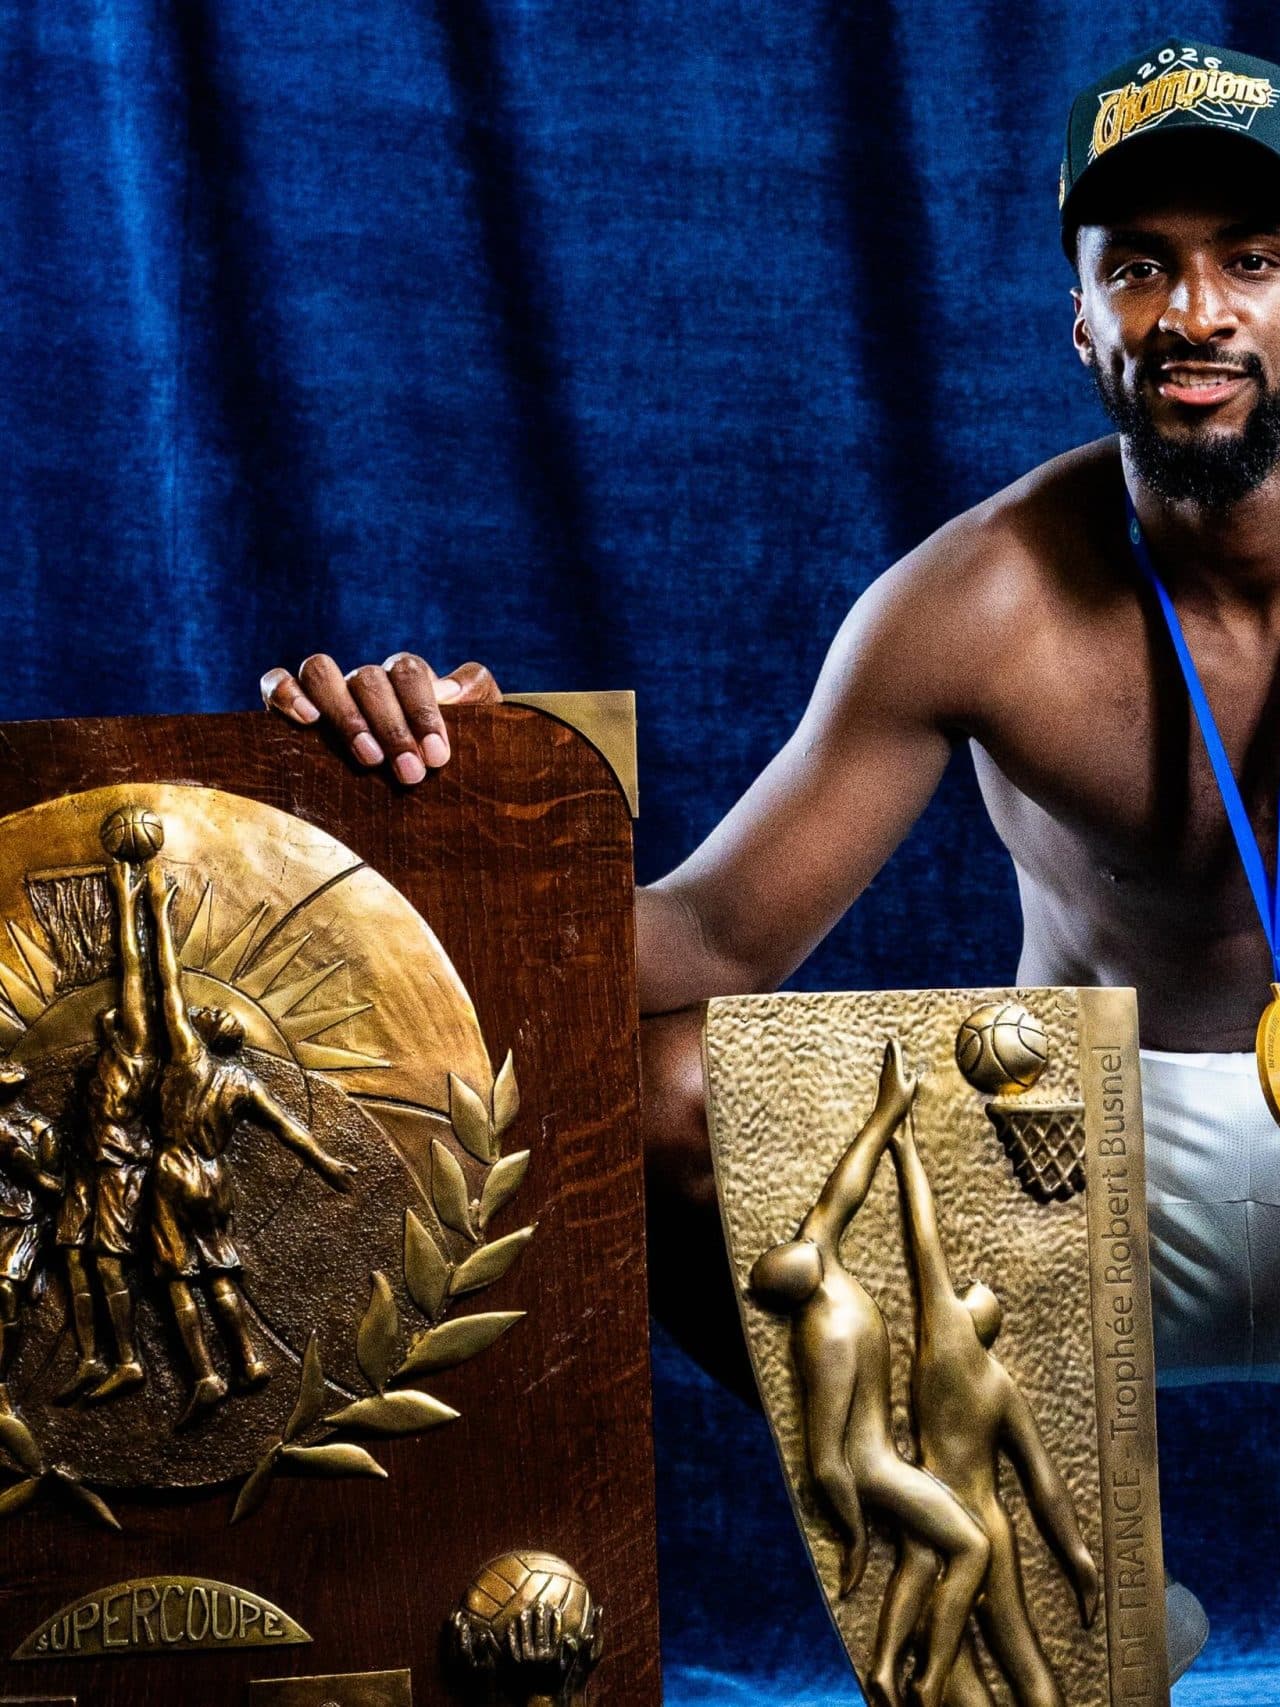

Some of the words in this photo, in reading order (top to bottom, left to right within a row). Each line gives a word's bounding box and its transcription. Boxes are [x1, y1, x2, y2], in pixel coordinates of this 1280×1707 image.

[1093, 69, 1272, 156] Champions
[1137, 48, 1222, 79] 2026
[1091, 1045, 1127, 1158] Busnel
[1101, 1167, 1132, 1286] Robert
[1105, 1296, 1143, 1441] Trophée
[1112, 1468, 1147, 1610] FRANCE
[35, 1584, 284, 1650] SUPERCOUPE
